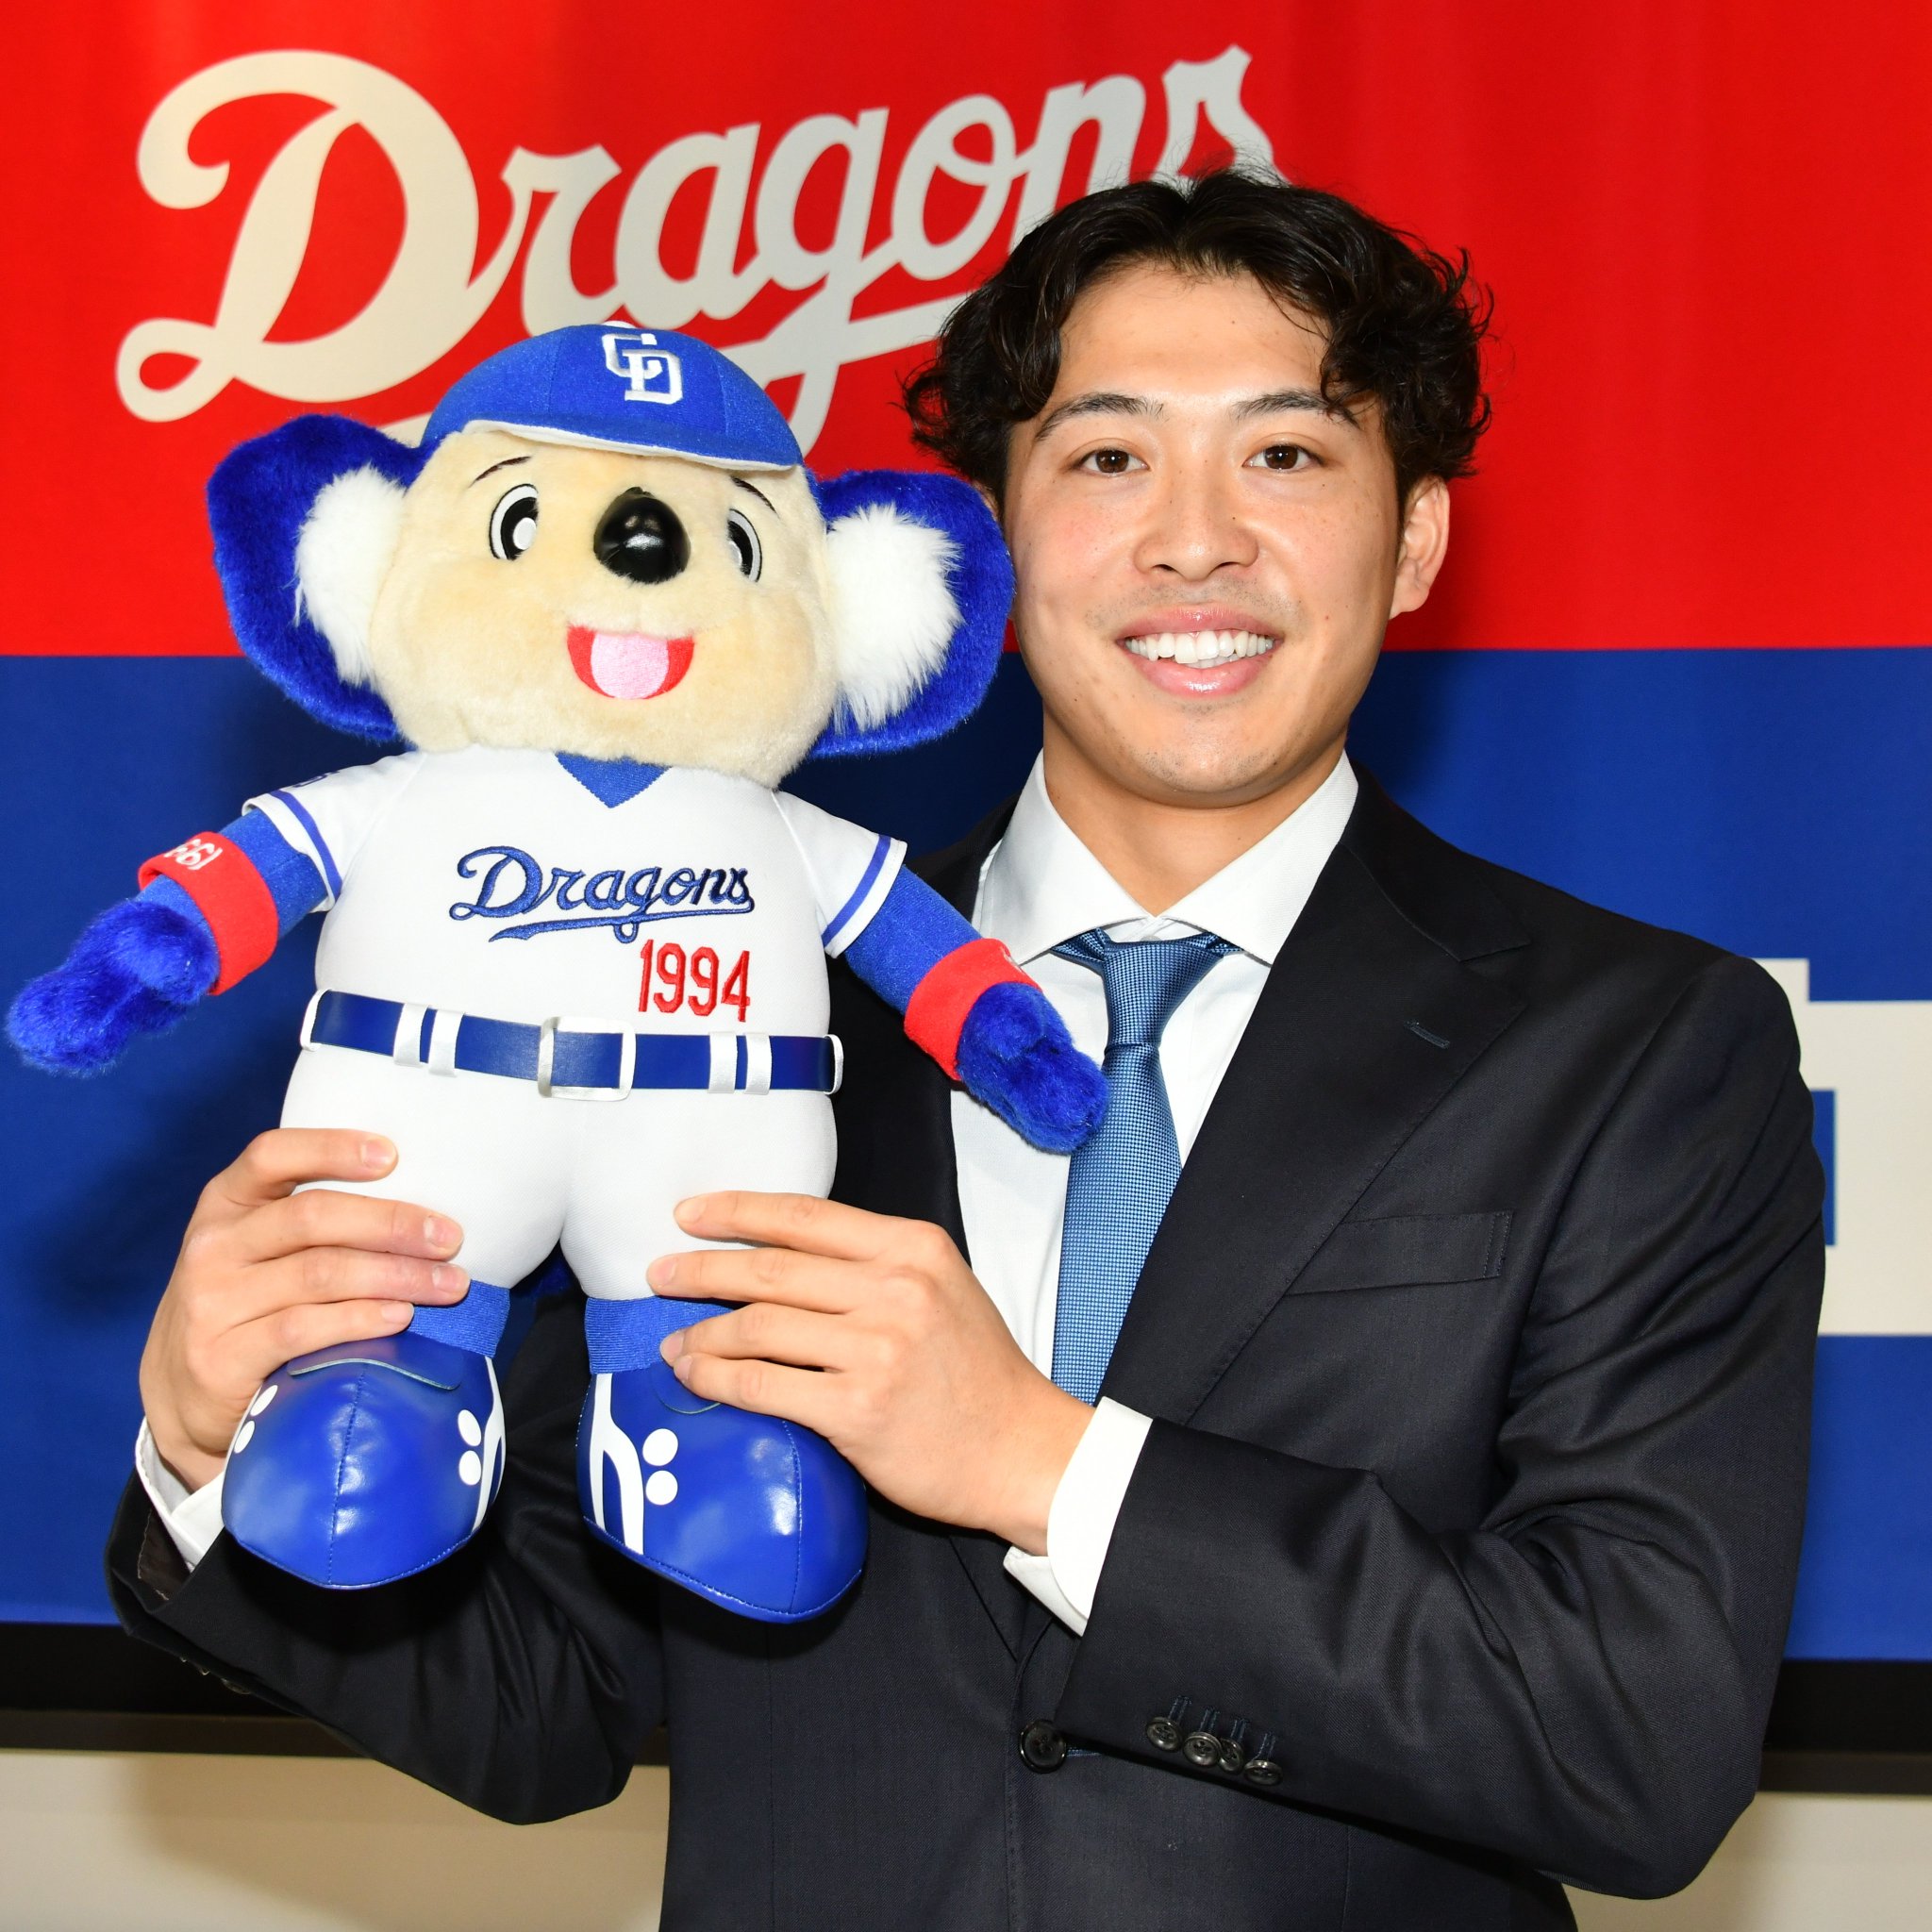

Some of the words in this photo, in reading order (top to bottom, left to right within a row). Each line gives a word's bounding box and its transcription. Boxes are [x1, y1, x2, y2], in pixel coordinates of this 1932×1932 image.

[116, 45, 1291, 458] Dragons
[448, 845, 756, 943] Dragons
[638, 939, 750, 1022] 1994
